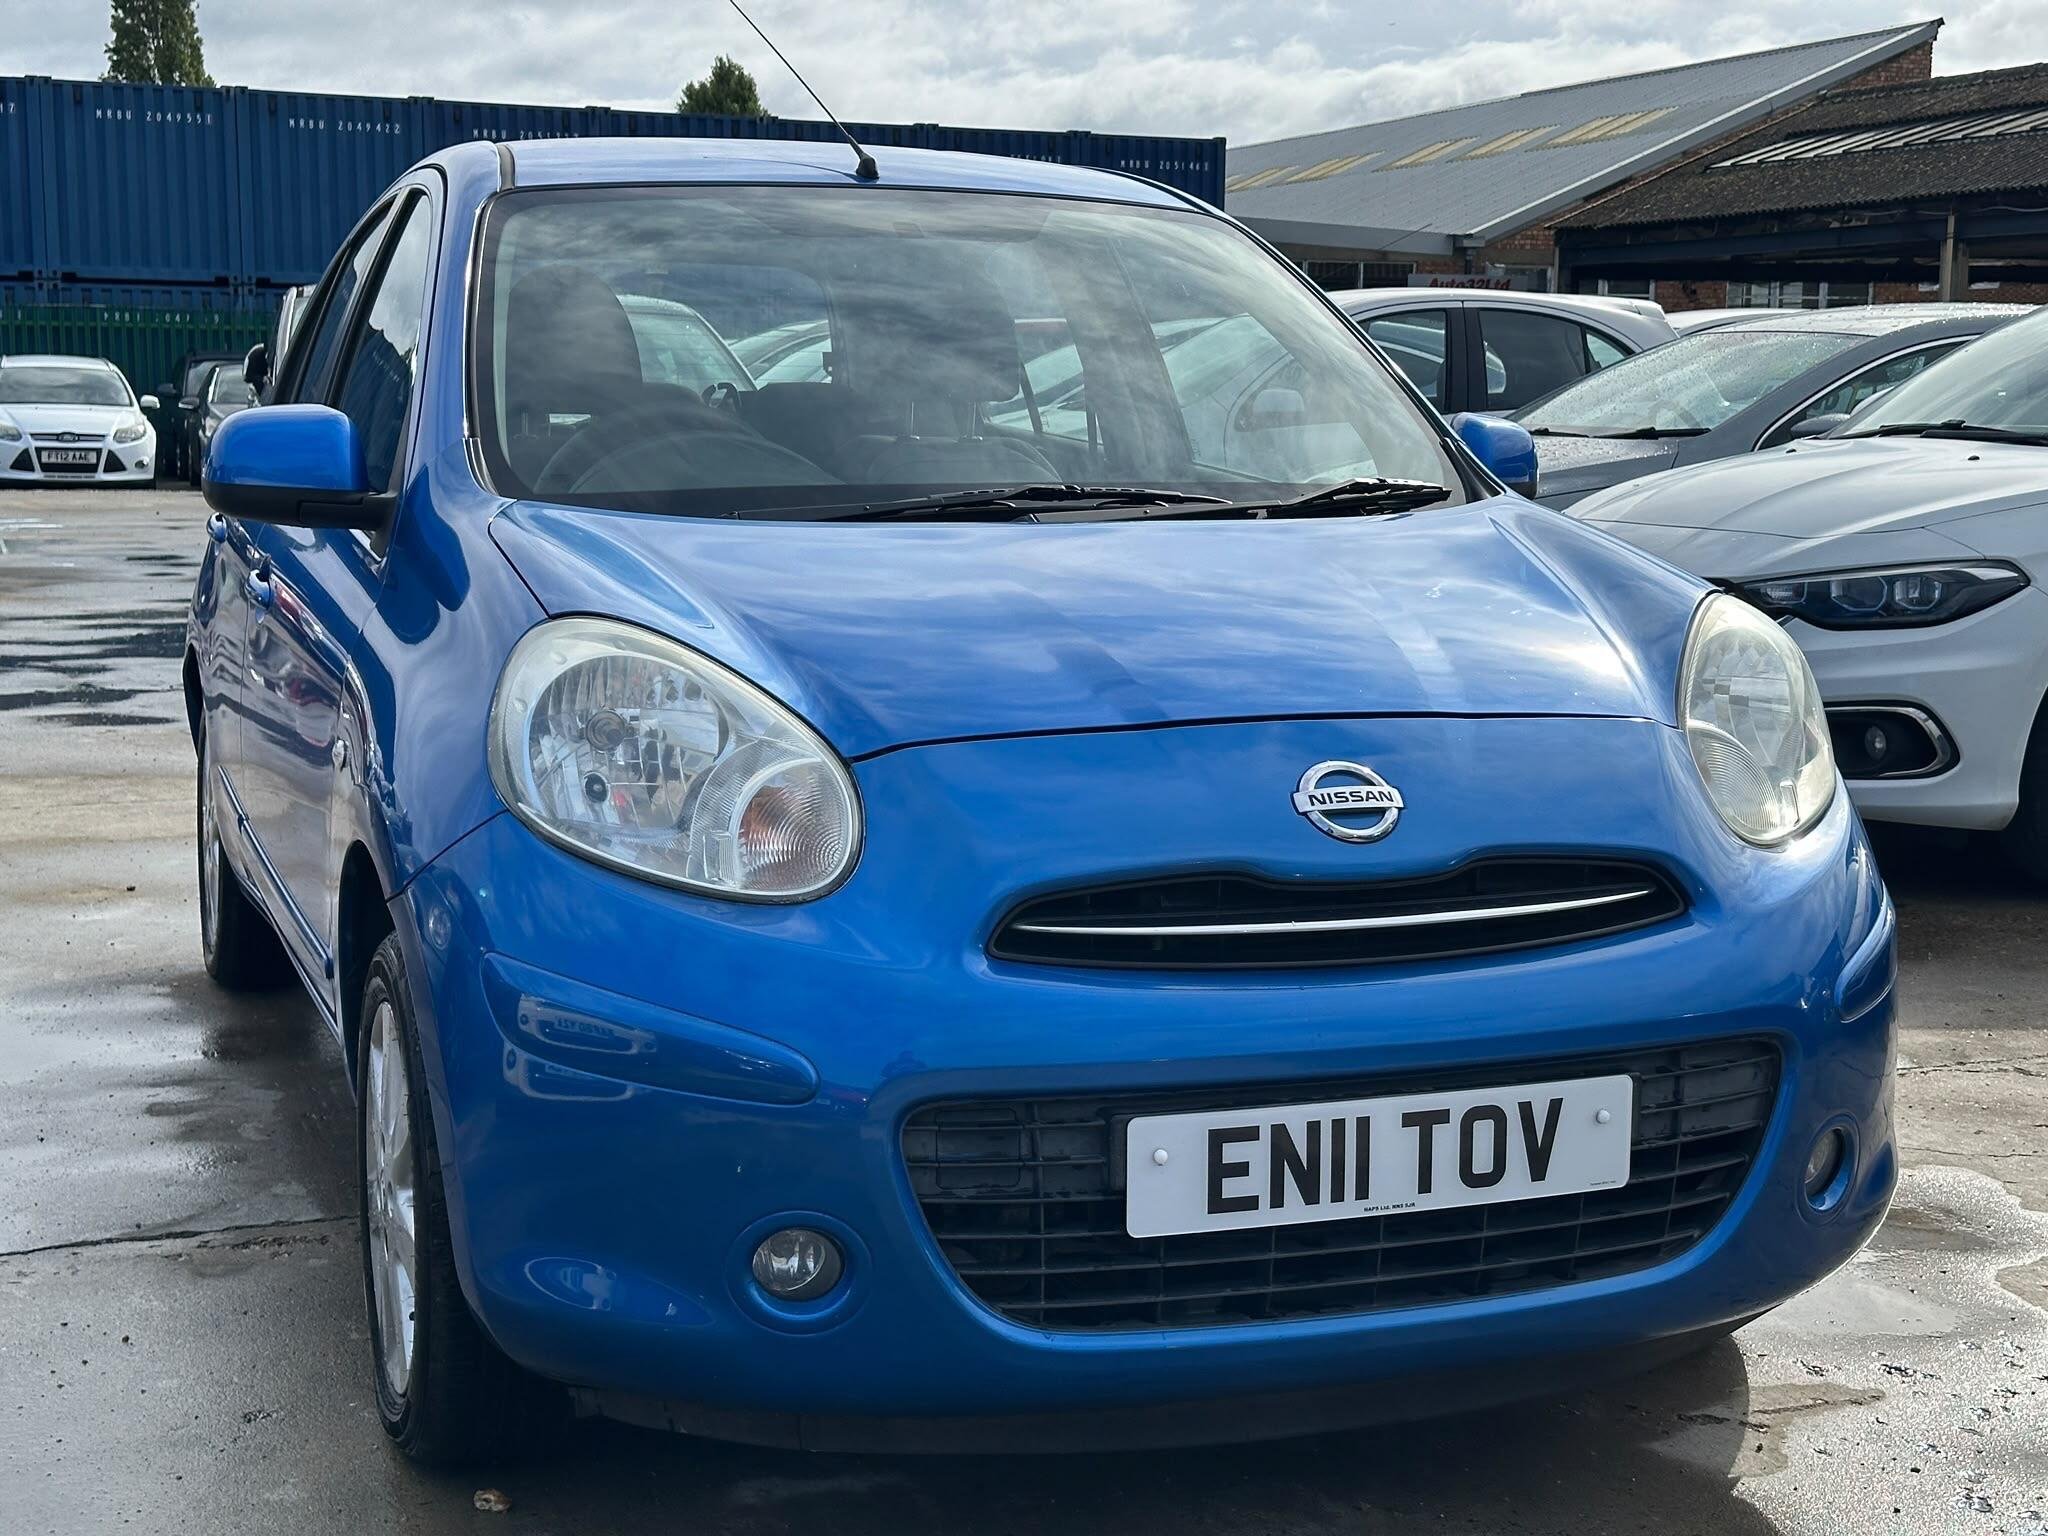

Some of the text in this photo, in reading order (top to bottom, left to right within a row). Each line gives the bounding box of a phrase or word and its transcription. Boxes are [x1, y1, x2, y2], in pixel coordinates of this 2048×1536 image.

[1308, 790, 1394, 807] NISSAN
[1206, 1097, 1564, 1215] EN11 TOV
